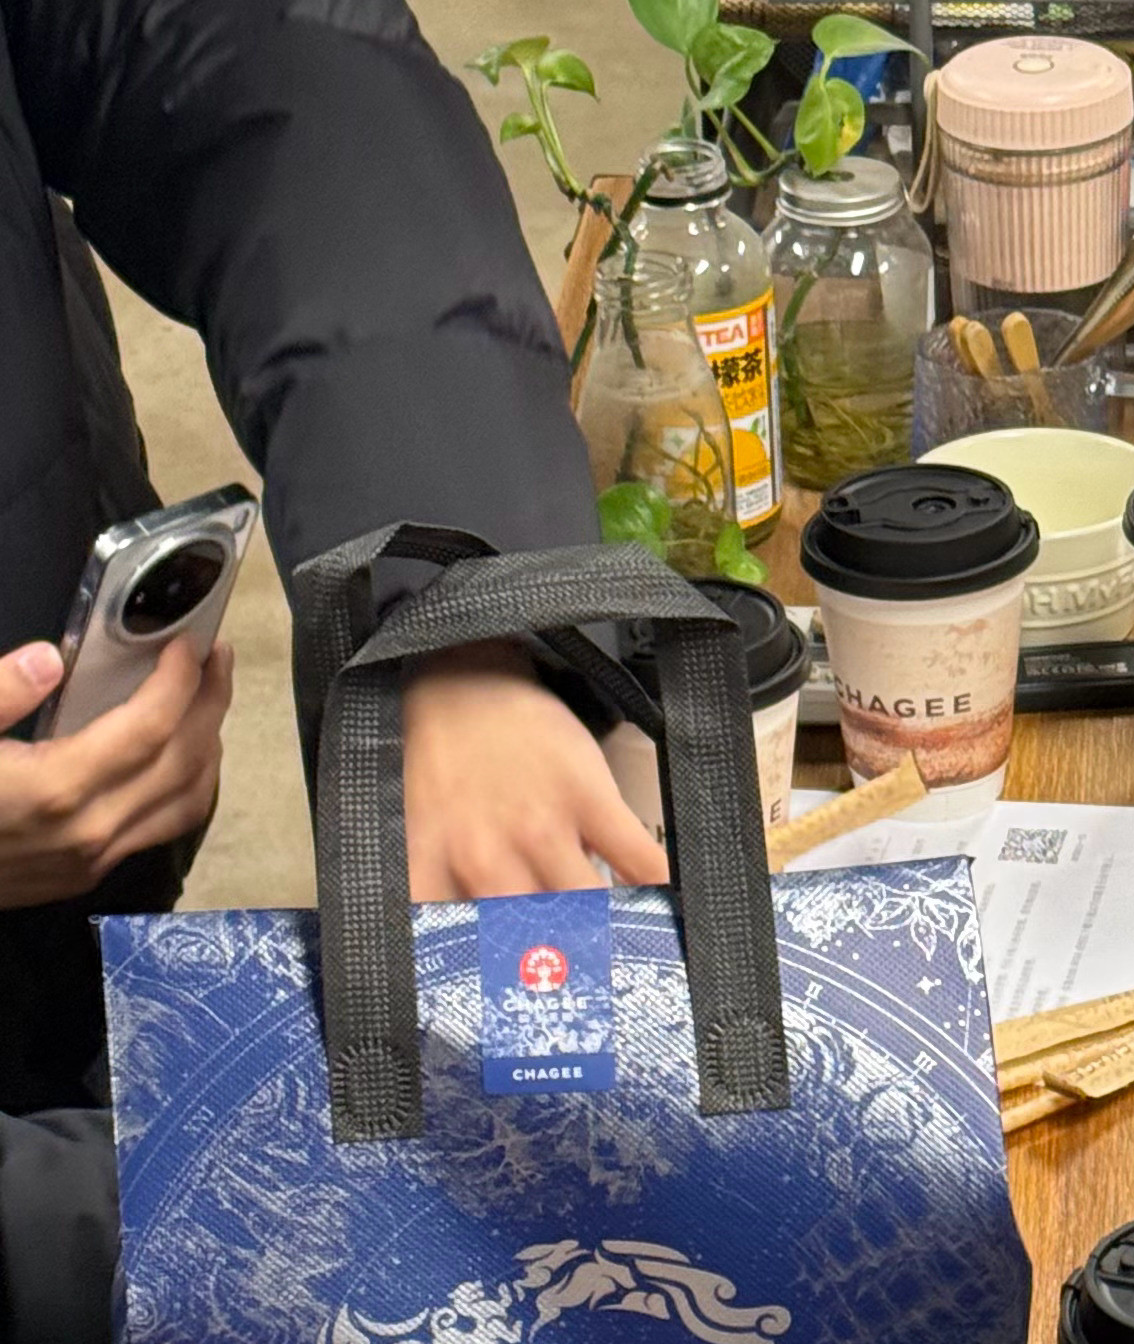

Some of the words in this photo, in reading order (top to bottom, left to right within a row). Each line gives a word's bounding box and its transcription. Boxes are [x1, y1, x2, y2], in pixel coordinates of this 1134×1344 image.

[700, 325, 745, 347] TEA
[711, 347, 762, 389] 檬茶
[835, 675, 972, 718] CHAGEE
[512, 1066, 584, 1082] CHAGEE
